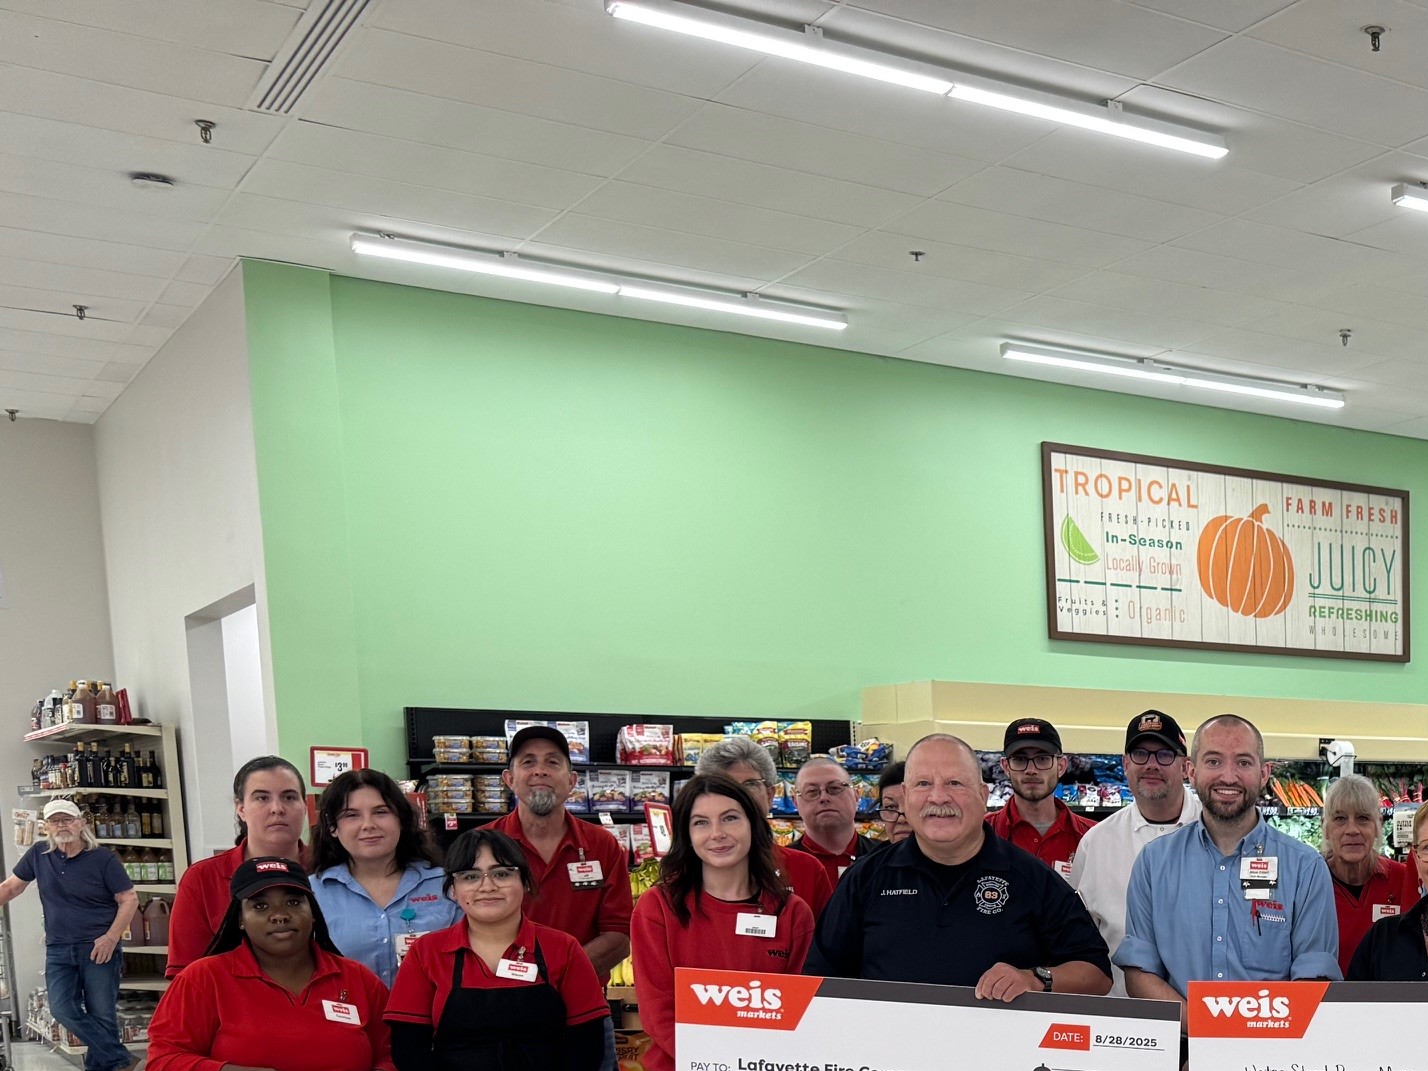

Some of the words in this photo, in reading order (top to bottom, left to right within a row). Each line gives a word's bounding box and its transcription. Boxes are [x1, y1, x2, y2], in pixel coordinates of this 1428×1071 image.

[1054, 468, 1199, 509] TROPICAL
[1286, 497, 1333, 518] FARM
[1346, 503, 1399, 525] FRESH
[1100, 512, 1190, 531] FRESH-PICKED
[1105, 530, 1183, 551] In-Season
[1105, 553, 1143, 577] Locally
[1149, 556, 1182, 578] Grown
[1309, 541, 1396, 596] JUICY
[1057, 596, 1096, 607] Fruits
[1058, 605, 1107, 617] Veggies
[1128, 600, 1186, 624] Organic
[1308, 605, 1399, 624] REFRESHING
[1309, 625, 1399, 642] WHOLESOME
[1256, 900, 1284, 911] weis
[691, 980, 782, 1011] weis
[1202, 990, 1291, 1020] weis
[737, 1009, 782, 1020] markets
[1246, 1018, 1290, 1030] markets
[1053, 1030, 1084, 1044] DATE:
[1095, 1033, 1158, 1048] 8/28/2025
[690, 1060, 711, 1071] PAY
